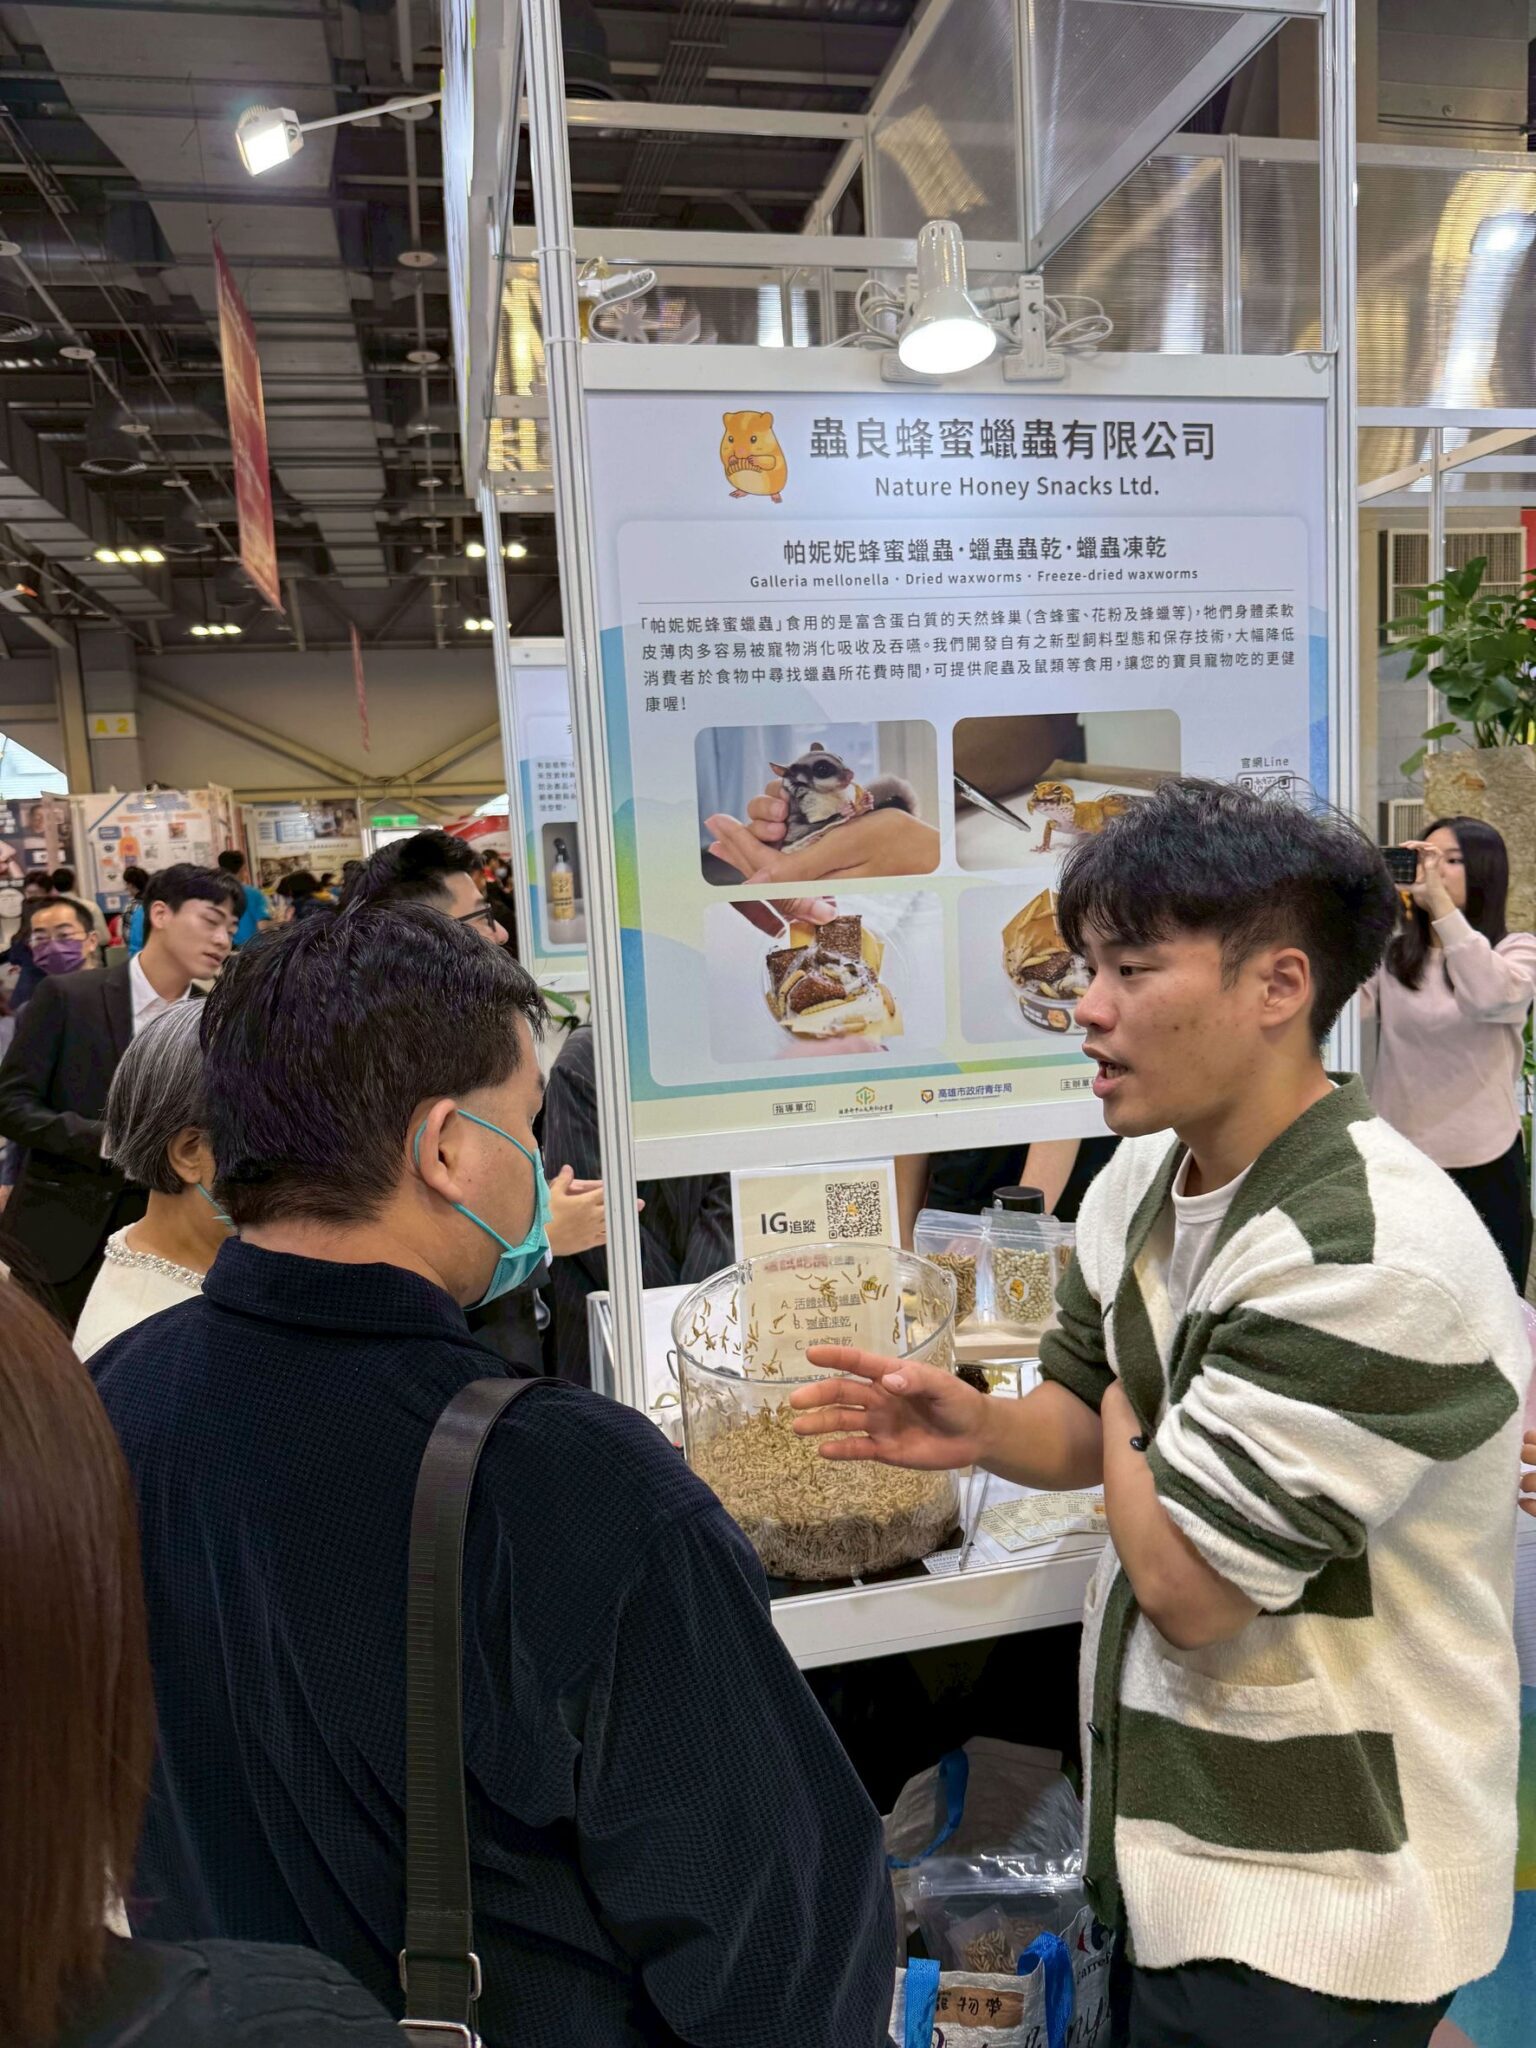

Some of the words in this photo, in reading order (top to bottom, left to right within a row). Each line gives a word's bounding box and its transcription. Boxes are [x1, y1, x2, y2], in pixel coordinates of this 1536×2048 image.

[809, 416, 1214, 461] 蟲良蜂蜜蠟蟲有限公司
[875, 476, 952, 497] Nature
[959, 476, 1030, 501] Honey
[1037, 475, 1113, 496] Snacks
[1119, 475, 1160, 496] Ltd.
[750, 575, 808, 588] Galleria
[813, 573, 890, 587] mellonella
[905, 572, 943, 585] Dried
[947, 571, 1022, 584] waxworms
[1037, 568, 1123, 583] Freeze-dried
[1128, 568, 1199, 580] waxworms
[95, 718, 109, 734] A
[116, 716, 129, 733] 2
[938, 1083, 1013, 1099] 高雄市政府青年局
[1063, 1079, 1094, 1089] 主辦單
[775, 1102, 814, 1114] 指導單位
